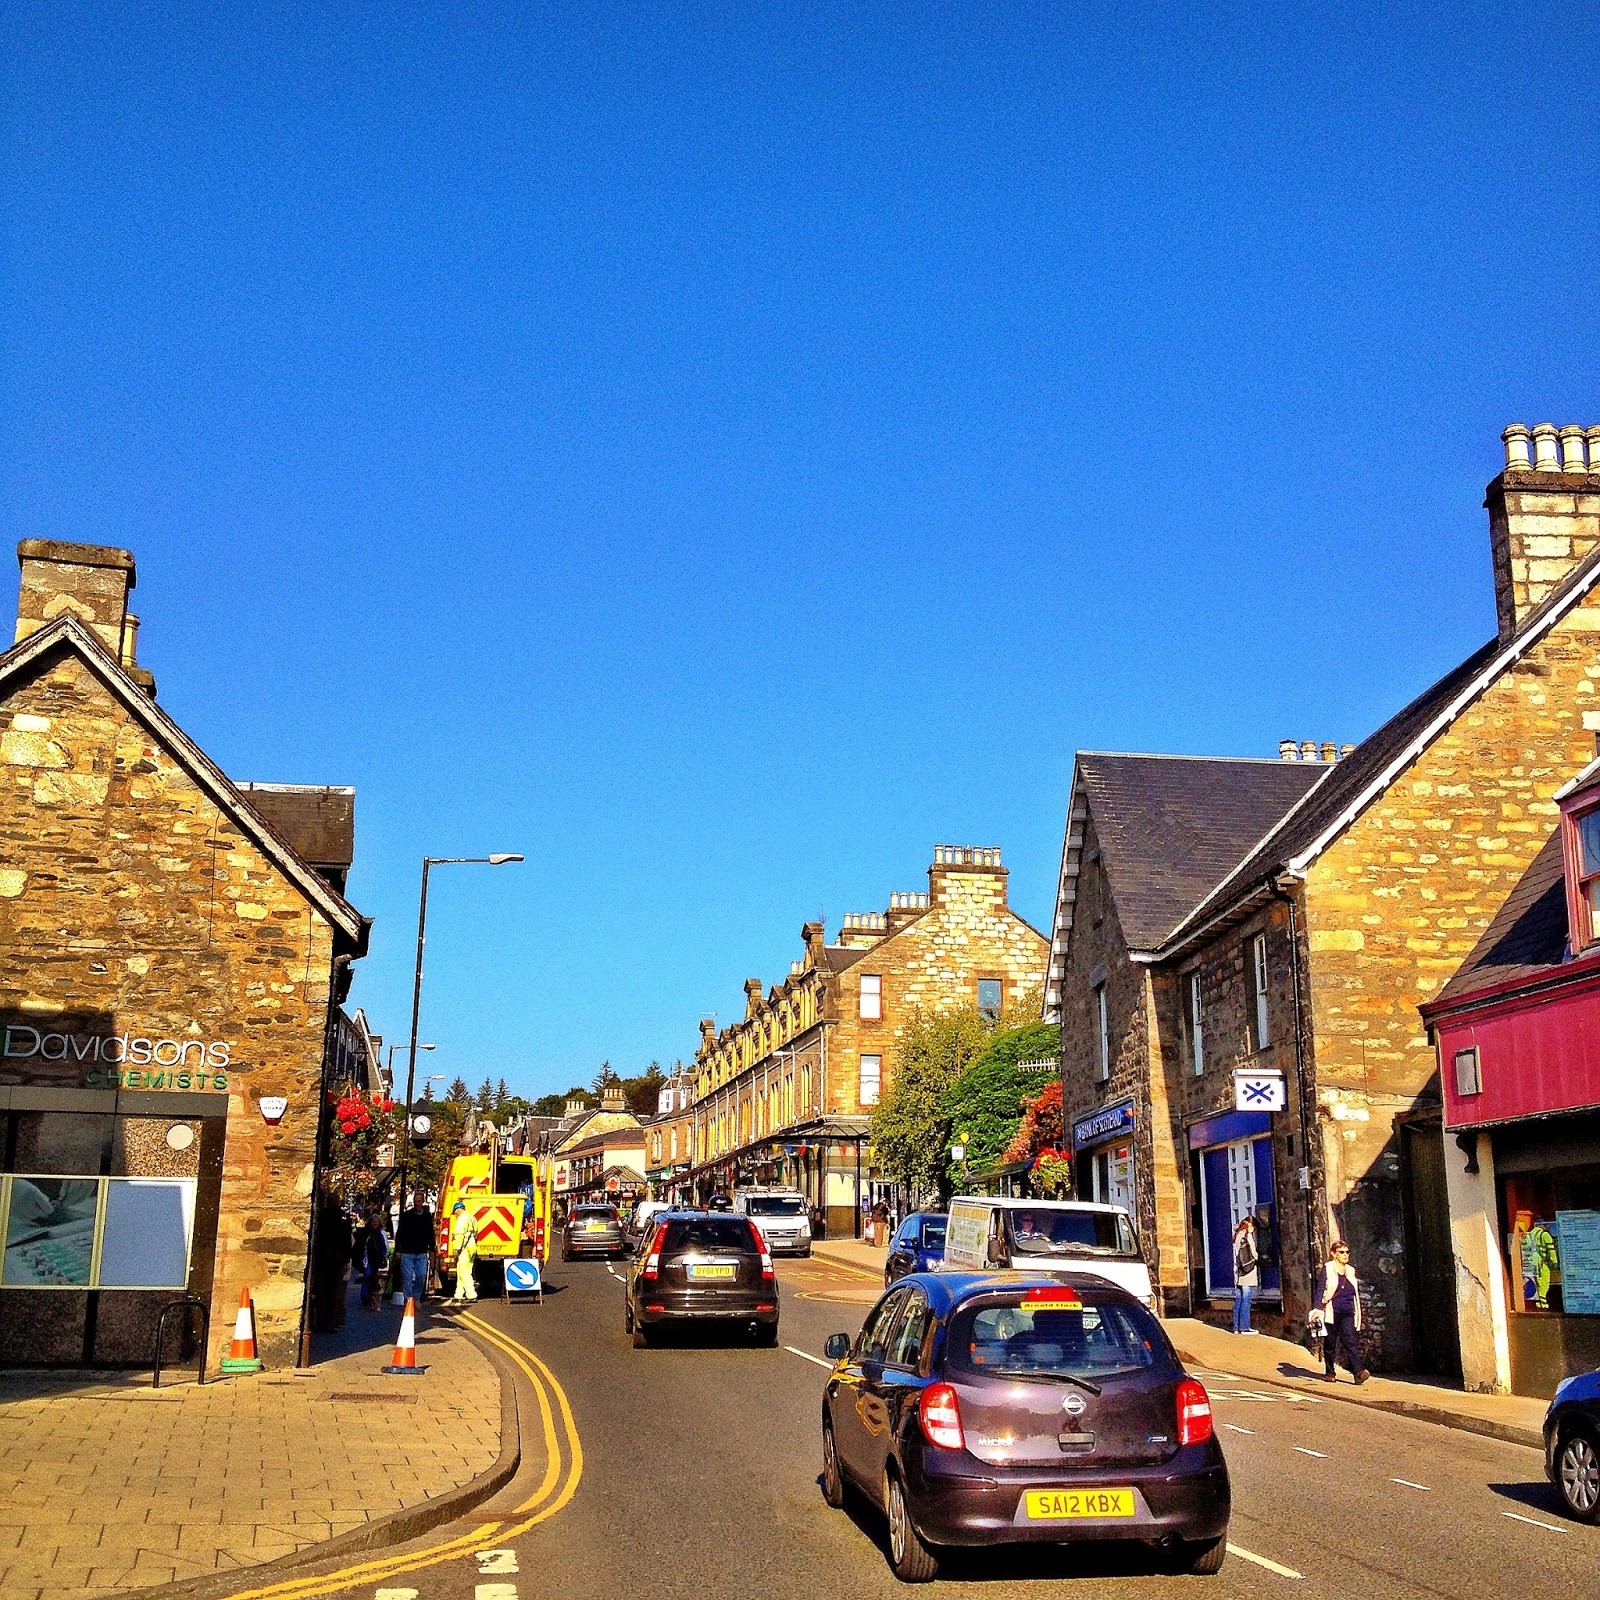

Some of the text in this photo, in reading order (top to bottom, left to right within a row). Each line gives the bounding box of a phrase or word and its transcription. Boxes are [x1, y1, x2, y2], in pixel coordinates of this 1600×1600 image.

[3, 1024, 230, 1068] Davidsons
[86, 1069, 228, 1090] CHEMISTS
[1039, 1494, 1122, 1513] SA12 KBX
